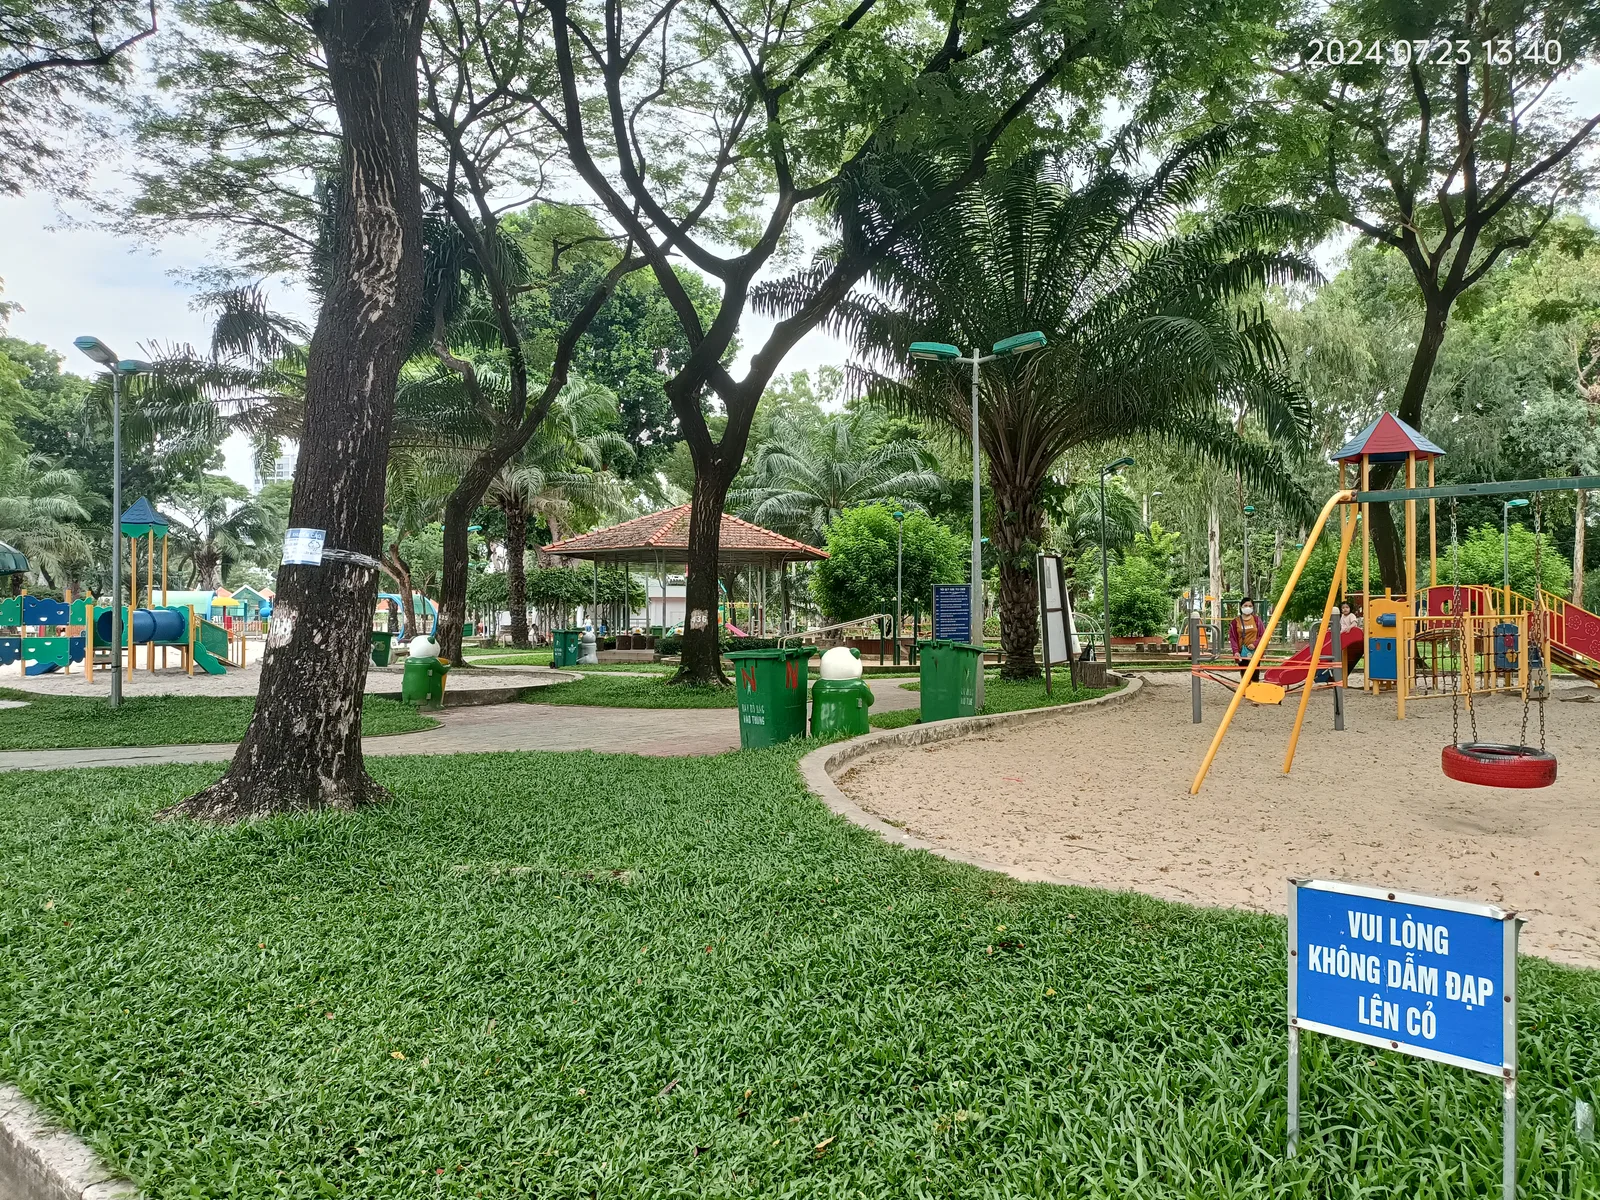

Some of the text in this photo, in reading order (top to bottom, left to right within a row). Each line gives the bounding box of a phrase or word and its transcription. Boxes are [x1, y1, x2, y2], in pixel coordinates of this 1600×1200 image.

[741, 666, 756, 692] N
[786, 661, 799, 689] N
[1347, 910, 1449, 956] VUI LÒNG
[1308, 944, 1494, 1011] KHÔNG DẪM ĐẠP
[1358, 993, 1437, 1040] LÊN CỎ
